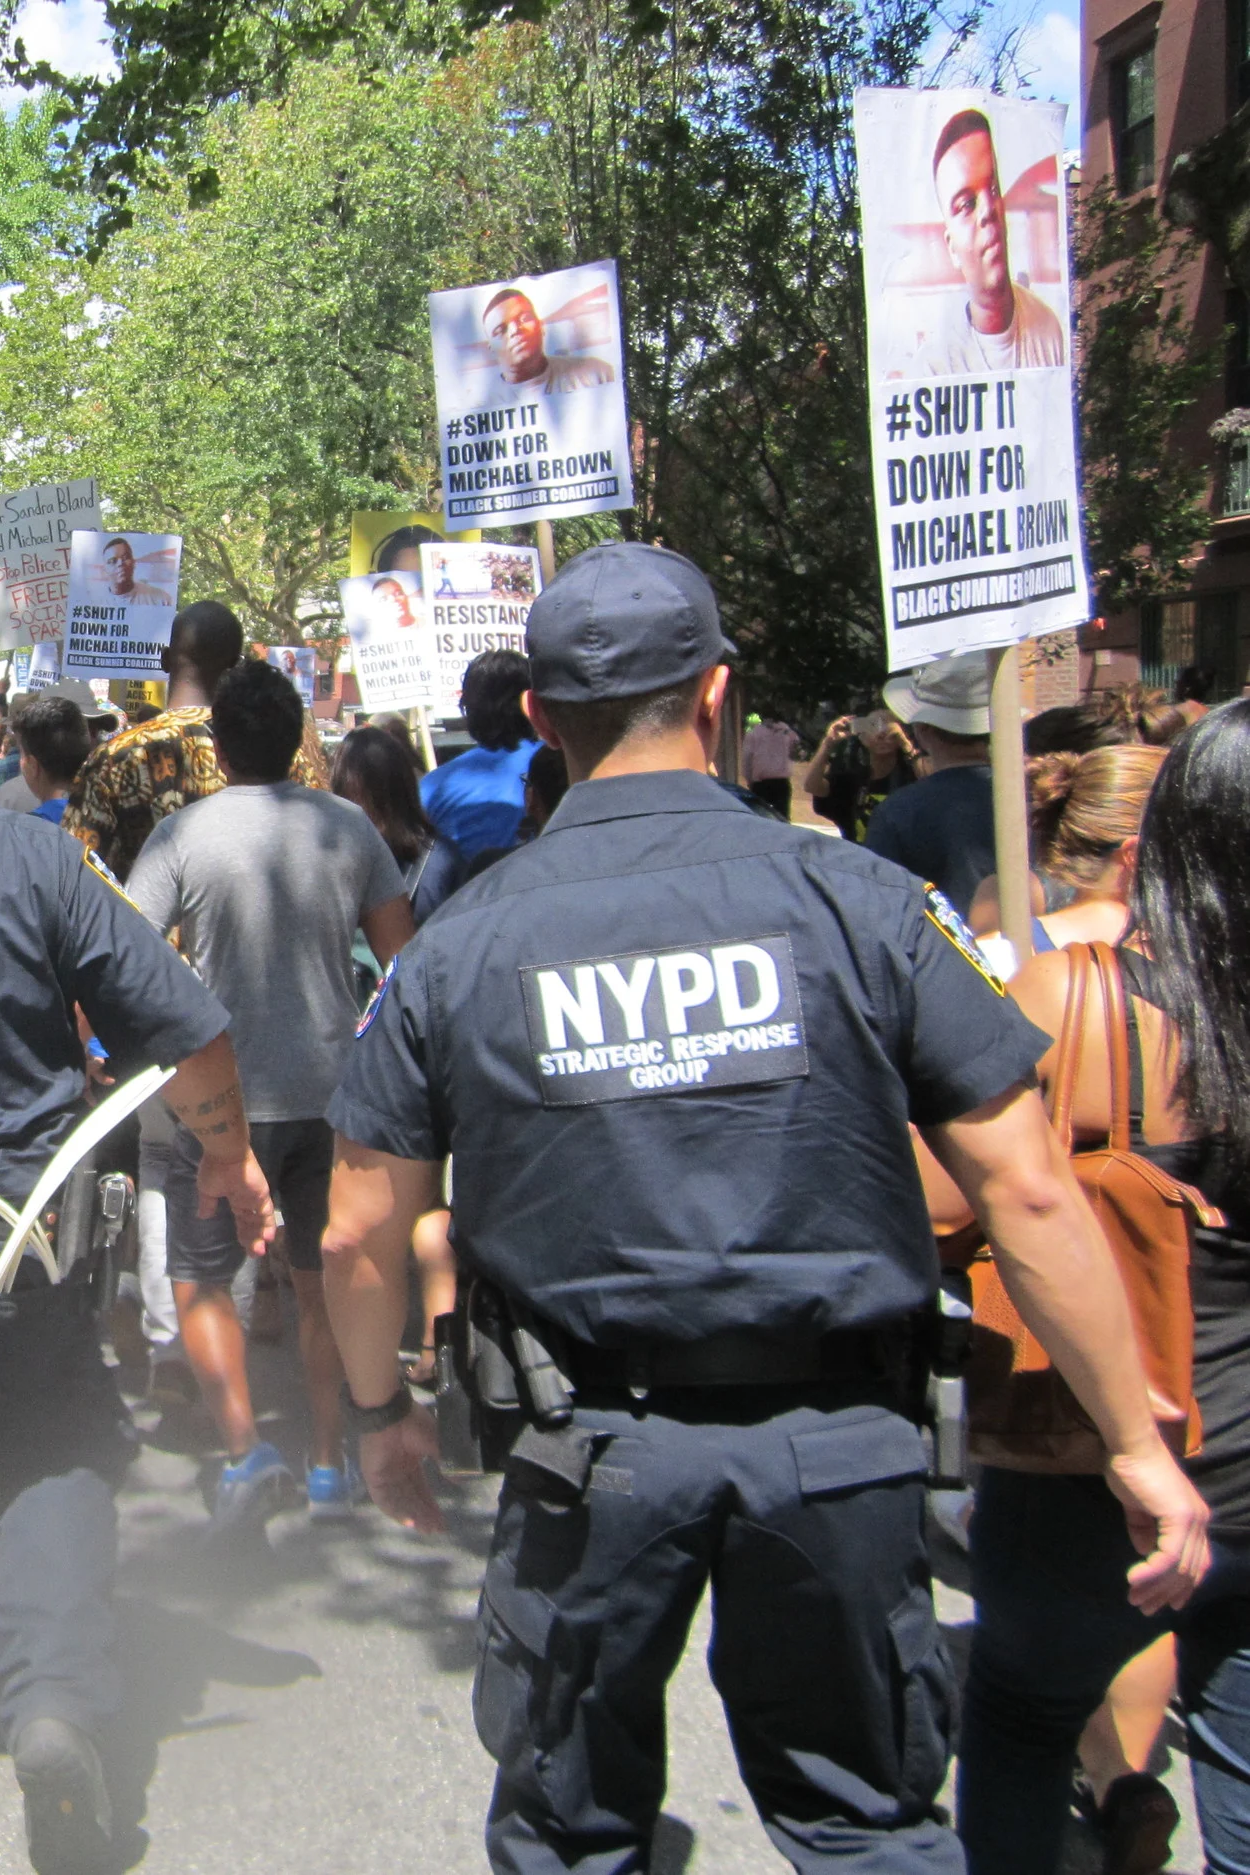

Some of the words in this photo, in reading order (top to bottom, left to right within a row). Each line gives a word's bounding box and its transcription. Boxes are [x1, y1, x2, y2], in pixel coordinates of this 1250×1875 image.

[447, 408, 516, 440] #SHUT
[520, 403, 539, 427] IT
[886, 382, 988, 442] #SHUT
[996, 380, 1015, 430] IT
[447, 438, 508, 466] DOWN
[513, 431, 549, 457] FOR
[449, 461, 534, 494] MICHAEL
[537, 449, 613, 481] BROWN
[887, 449, 971, 507] DOWN
[979, 444, 1025, 495] FOR
[4, 490, 54, 524] Sandra
[56, 480, 95, 514] Bland
[451, 498, 494, 515] BLACK
[495, 488, 548, 510] SUMMER
[550, 479, 617, 504] COALITION
[8, 520, 53, 550] Michael
[891, 508, 1012, 571] MICHAEL
[1016, 498, 1069, 551] BROWN
[21, 552, 61, 576] Police
[896, 584, 949, 622] BLACK
[950, 570, 1024, 612] SUMMER
[1023, 560, 1073, 600] COALITION
[72, 605, 114, 620] #SHUT
[117, 607, 126, 620] IT
[434, 604, 528, 626] RESISTANC
[70, 621, 108, 636] DOWN
[110, 624, 129, 637] FOR
[436, 634, 454, 654] IS
[69, 637, 119, 654] MICHAEL
[121, 641, 165, 655] BROWN
[69, 655, 93, 664] BLACK
[359, 641, 400, 657] #SHUT
[404, 640, 414, 649] IT
[362, 661, 399, 674] DOWN
[402, 656, 422, 669] FOR
[440, 674, 454, 686] to
[366, 674, 417, 689] MICHAEL
[537, 944, 781, 1050] NYPD
[539, 1041, 664, 1076] STRATEGIC
[670, 1023, 800, 1060] RESPONSE
[630, 1059, 710, 1089] GROUP
